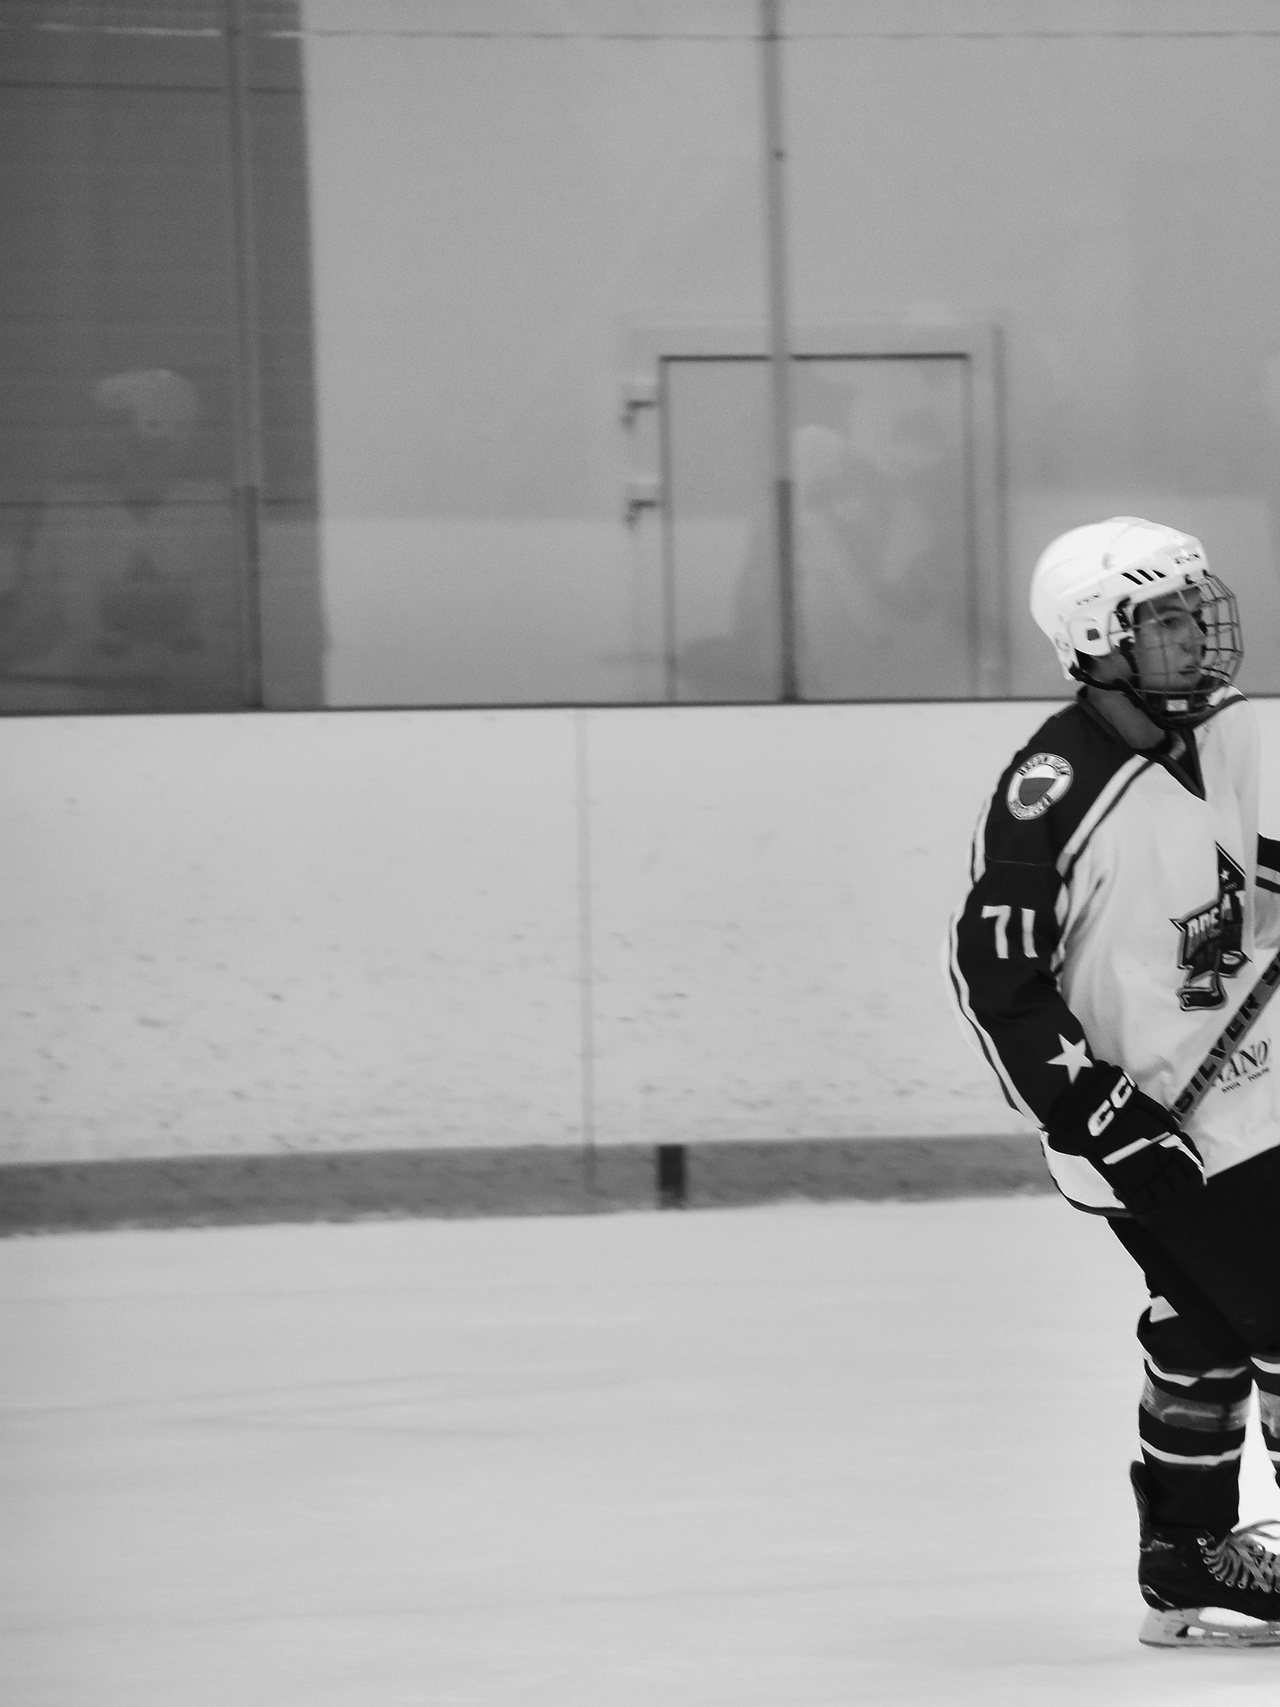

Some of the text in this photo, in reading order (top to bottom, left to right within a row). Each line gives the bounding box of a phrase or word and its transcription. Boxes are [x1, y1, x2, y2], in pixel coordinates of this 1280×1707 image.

[981, 904, 1038, 961] 71
[1174, 994, 1261, 1116] SILVER
[1087, 1074, 1134, 1137] CC
